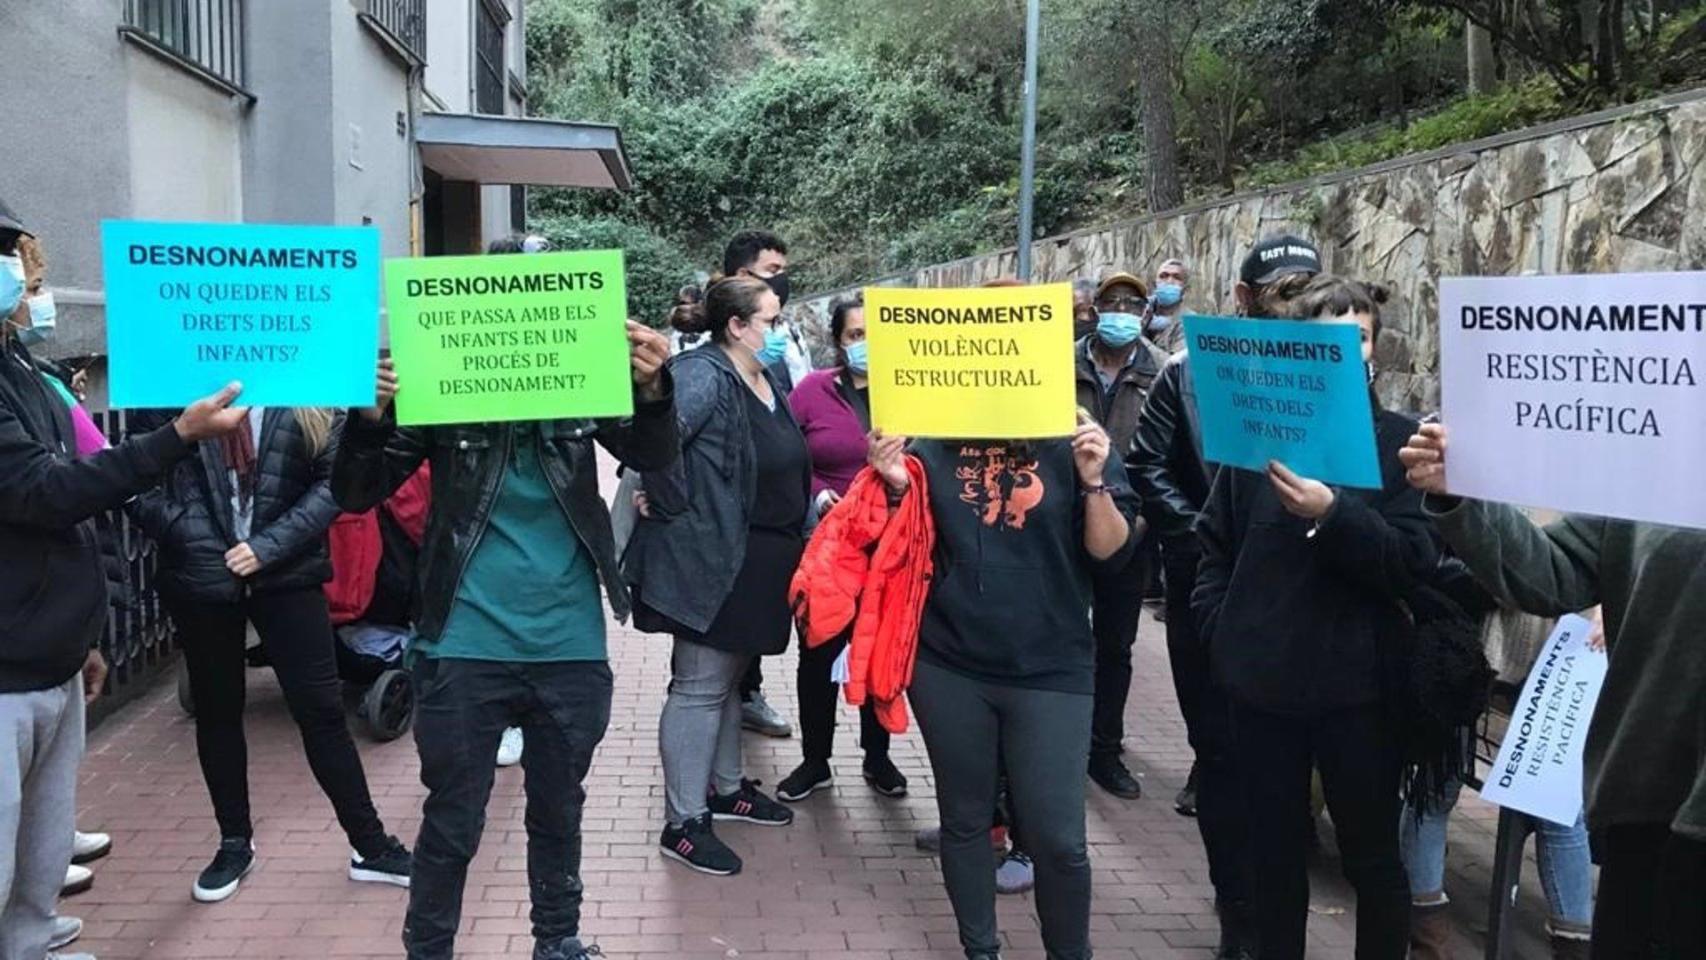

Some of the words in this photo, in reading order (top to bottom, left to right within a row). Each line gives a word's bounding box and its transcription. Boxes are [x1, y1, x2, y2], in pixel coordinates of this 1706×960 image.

[129, 244, 357, 269] DESNONAMENTS
[159, 282, 190, 301] ON
[198, 283, 288, 304] QUEDEN
[295, 284, 331, 302] ELS
[406, 271, 604, 297] DESNONAMENTS
[182, 313, 253, 332] DRETS
[260, 314, 312, 332] DELS
[418, 311, 456, 330] QUE
[461, 308, 516, 325] PASSA
[521, 306, 561, 323] AMB
[565, 304, 597, 321] ELS
[879, 304, 1053, 325] DESNONAMENTS
[440, 331, 519, 349] INFANTS
[524, 329, 546, 346] EN
[552, 328, 578, 344] UN
[908, 334, 1020, 357] VIOLÈNCIA
[1197, 334, 1343, 363] DESNONAMENTS
[197, 344, 299, 363] INFANTS?
[463, 350, 531, 371] PROCÉS
[536, 352, 560, 368] DE
[894, 369, 1042, 387] ESTRUCTURAL
[1216, 366, 1235, 381] ON
[1237, 368, 1294, 390] QUEDEN
[1299, 374, 1326, 392] ELS
[1487, 349, 1696, 386] RESISTÈNCIA
[439, 374, 587, 395] DESNONAMENT?
[1232, 393, 1274, 415] DRETS
[1277, 397, 1314, 417] DELS
[1516, 398, 1661, 437] PACÍFICA
[1242, 419, 1307, 443] INFANTS?
[1499, 631, 1571, 788] DESNONAMENTS
[1552, 680, 1588, 765] PACÍFICA
